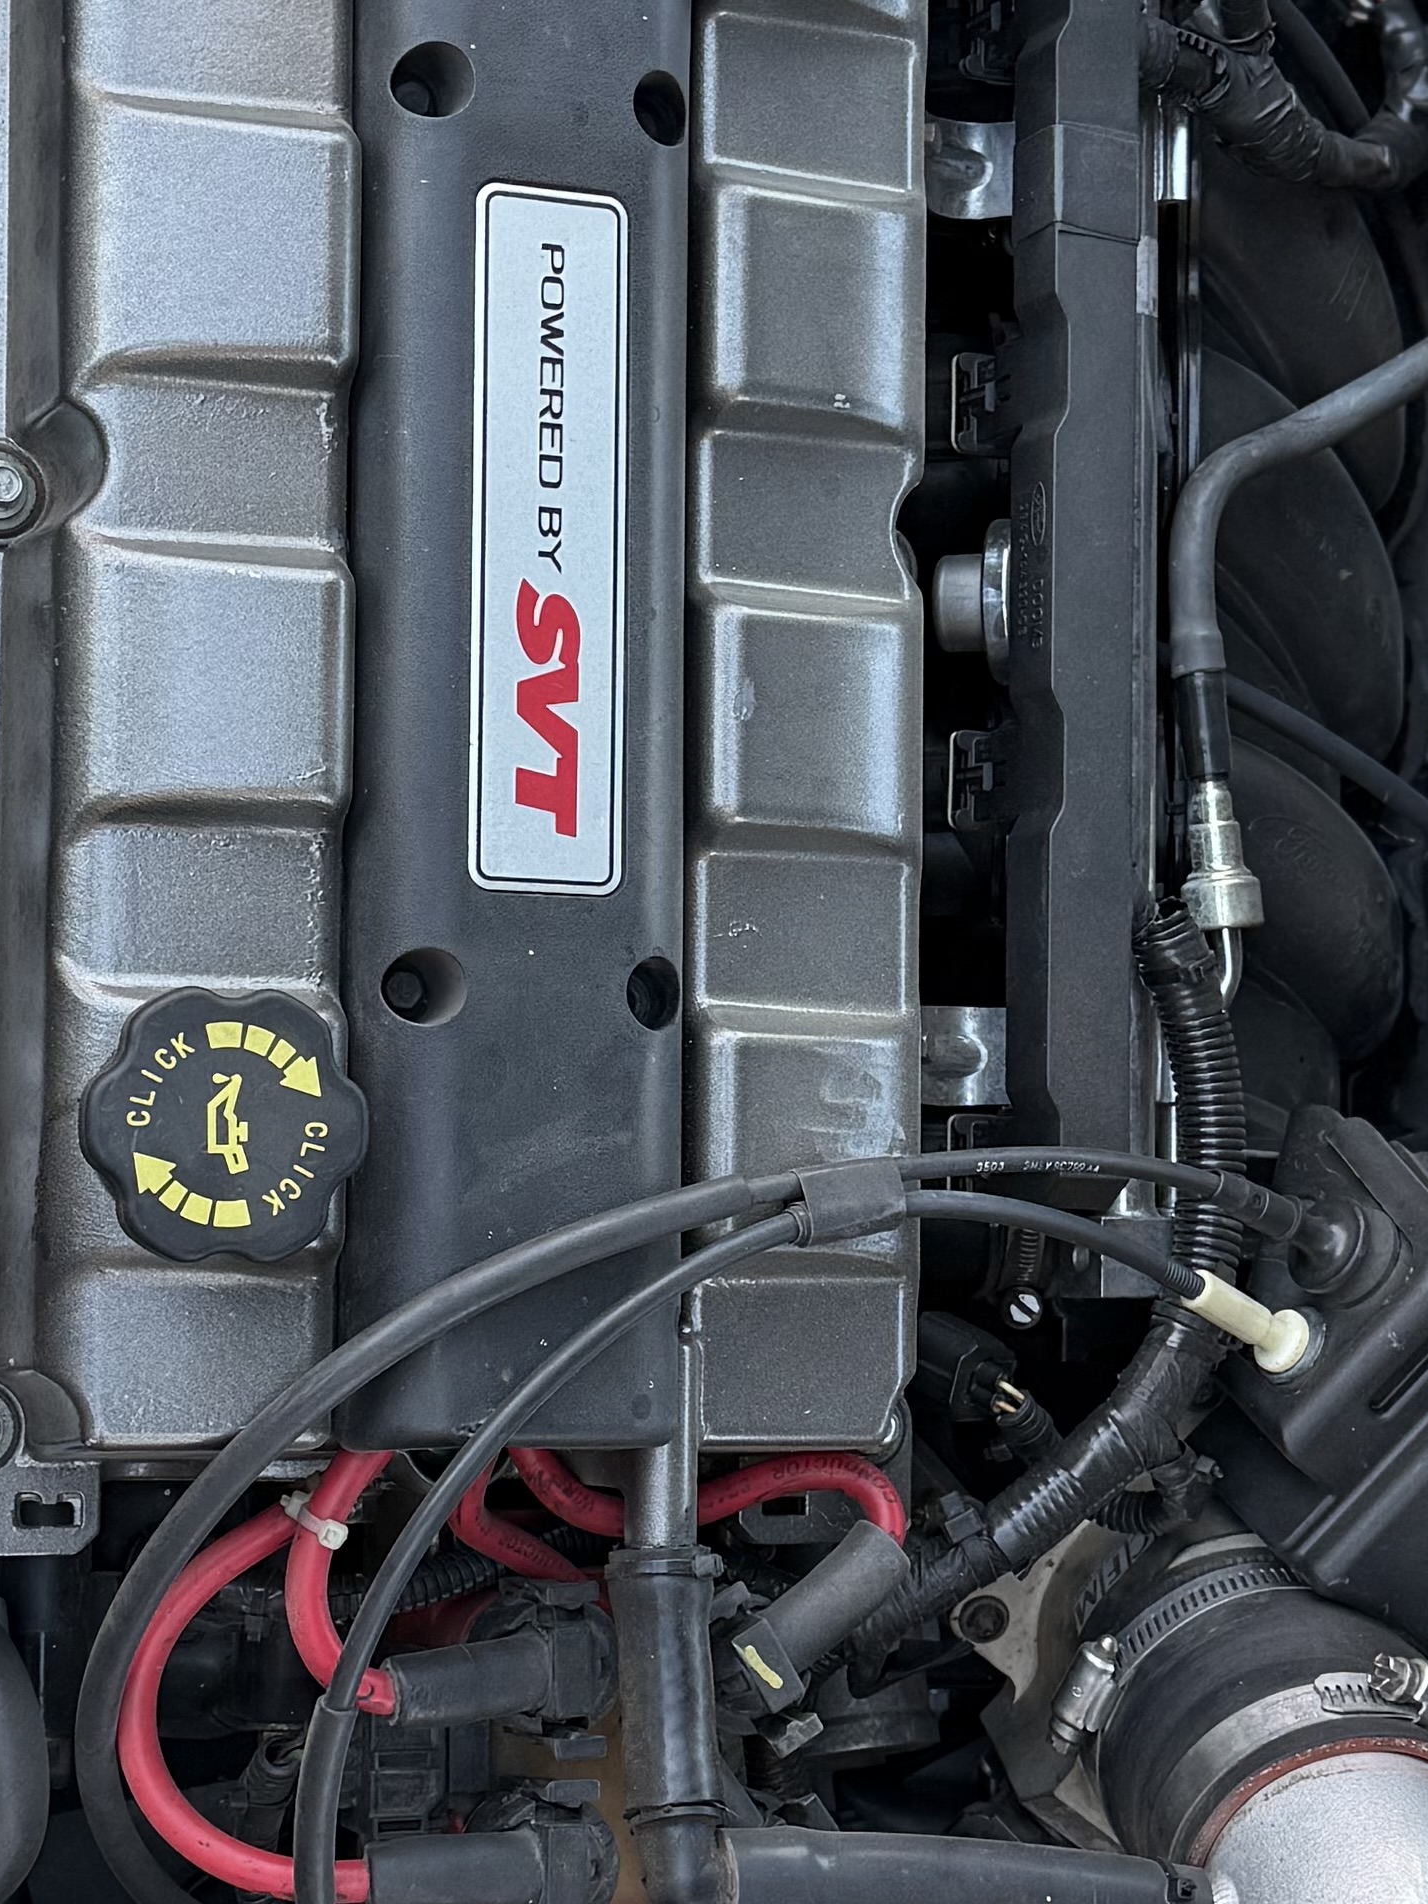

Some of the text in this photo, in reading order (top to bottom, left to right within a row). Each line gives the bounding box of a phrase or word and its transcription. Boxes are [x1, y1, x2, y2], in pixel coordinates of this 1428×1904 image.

[515, 243, 581, 837] POWERED BY SVT
[126, 1032, 196, 1126] CLICK
[262, 1122, 328, 1216] CLICK
